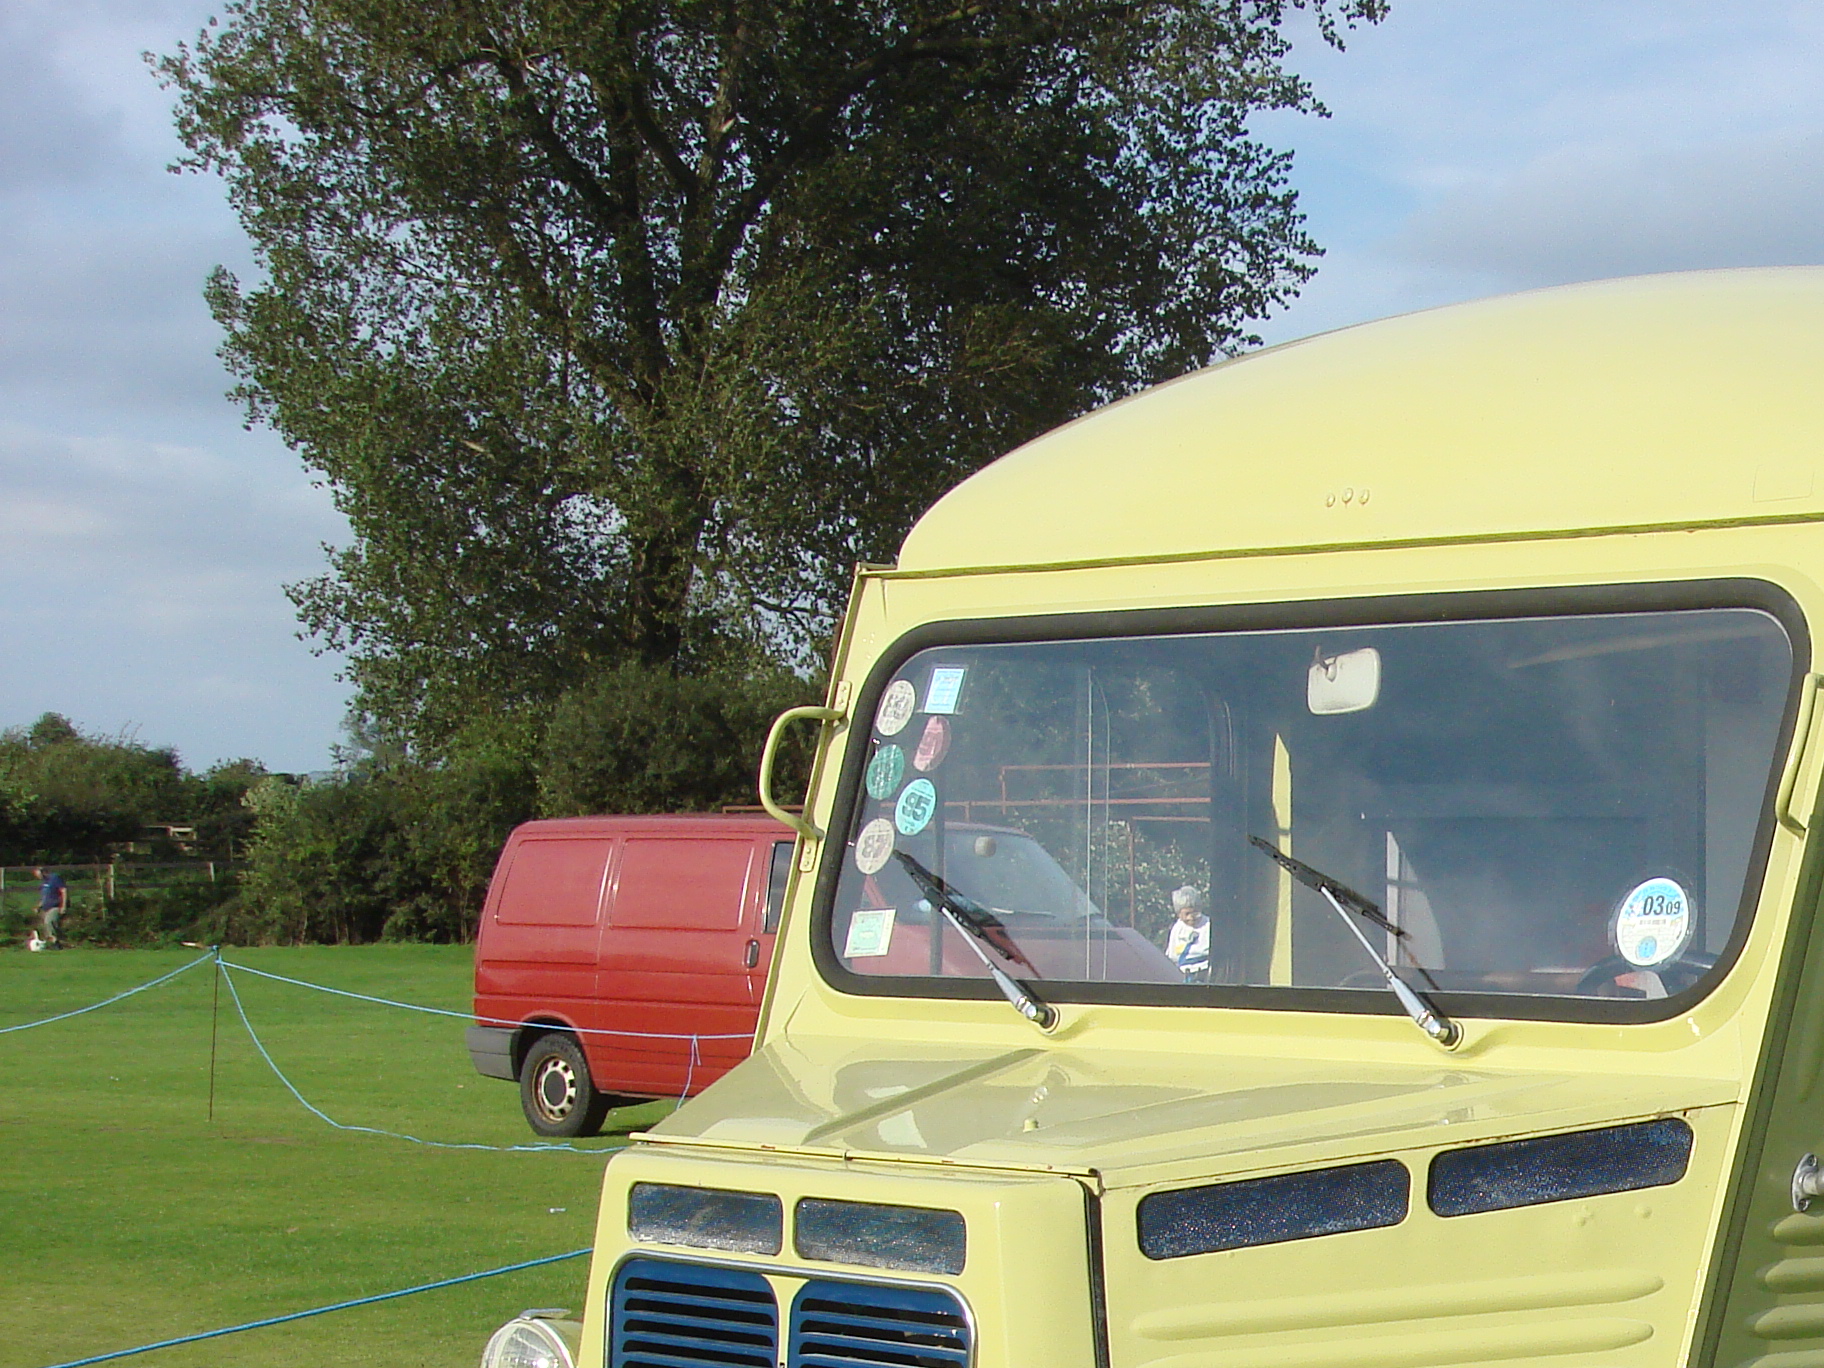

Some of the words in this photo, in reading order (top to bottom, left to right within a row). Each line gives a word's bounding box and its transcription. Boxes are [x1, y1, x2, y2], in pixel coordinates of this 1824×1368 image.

[902, 792, 931, 822] 95
[1643, 895, 1665, 916] 03
[1665, 900, 1681, 916] 09
